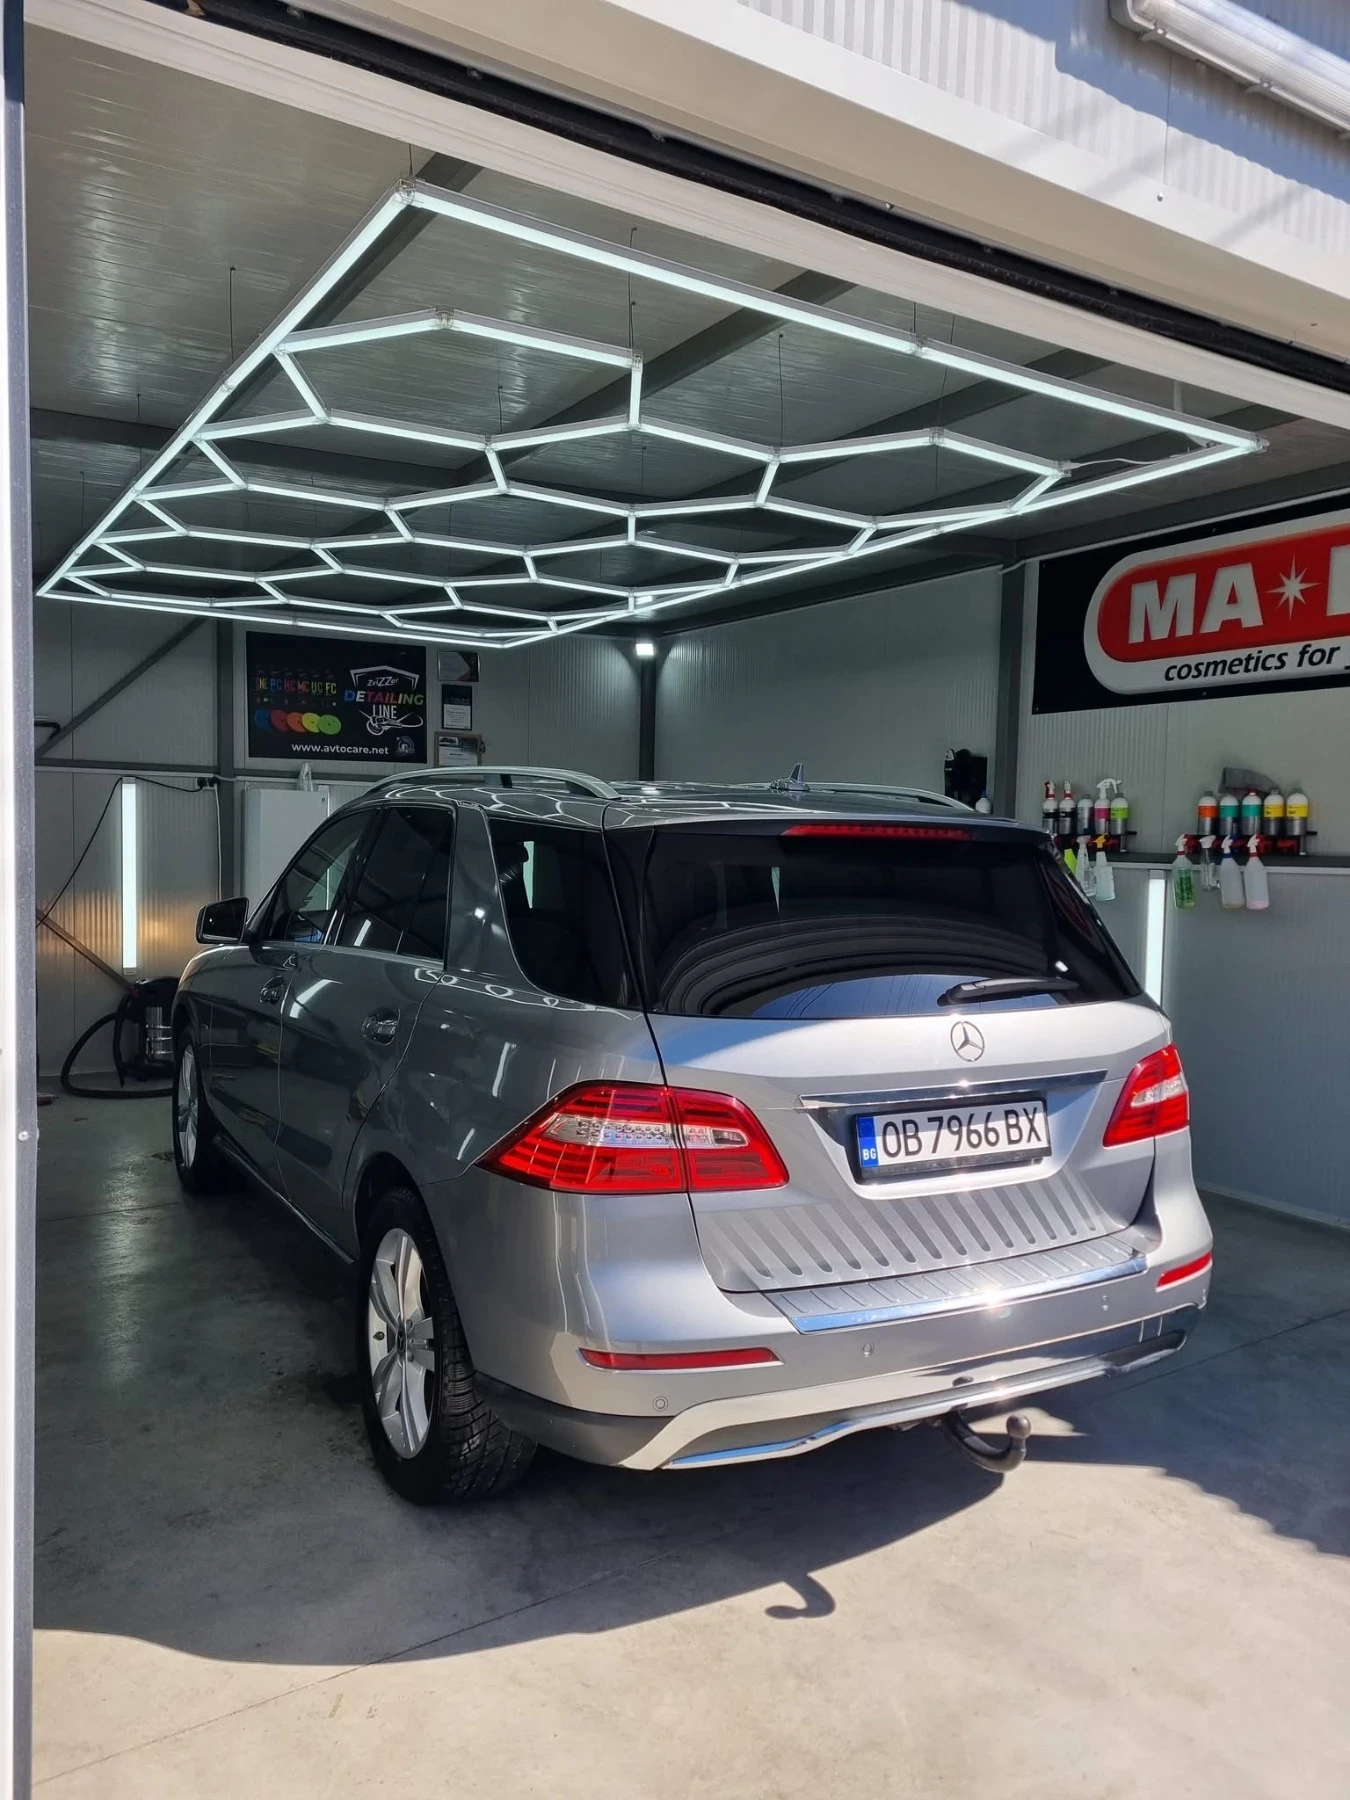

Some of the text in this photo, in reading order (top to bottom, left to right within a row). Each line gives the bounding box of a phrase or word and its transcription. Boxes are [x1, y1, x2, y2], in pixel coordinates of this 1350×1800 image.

[1164, 643, 1341, 682] cosmetics for
[311, 681, 324, 694] UC
[325, 682, 337, 695] FC
[343, 689, 424, 706] DETAILING
[373, 704, 398, 719] LINE
[291, 743, 389, 755] www.avtocare.net
[882, 1106, 1042, 1159] OB 7966 BX
[862, 1148, 877, 1161] BG
